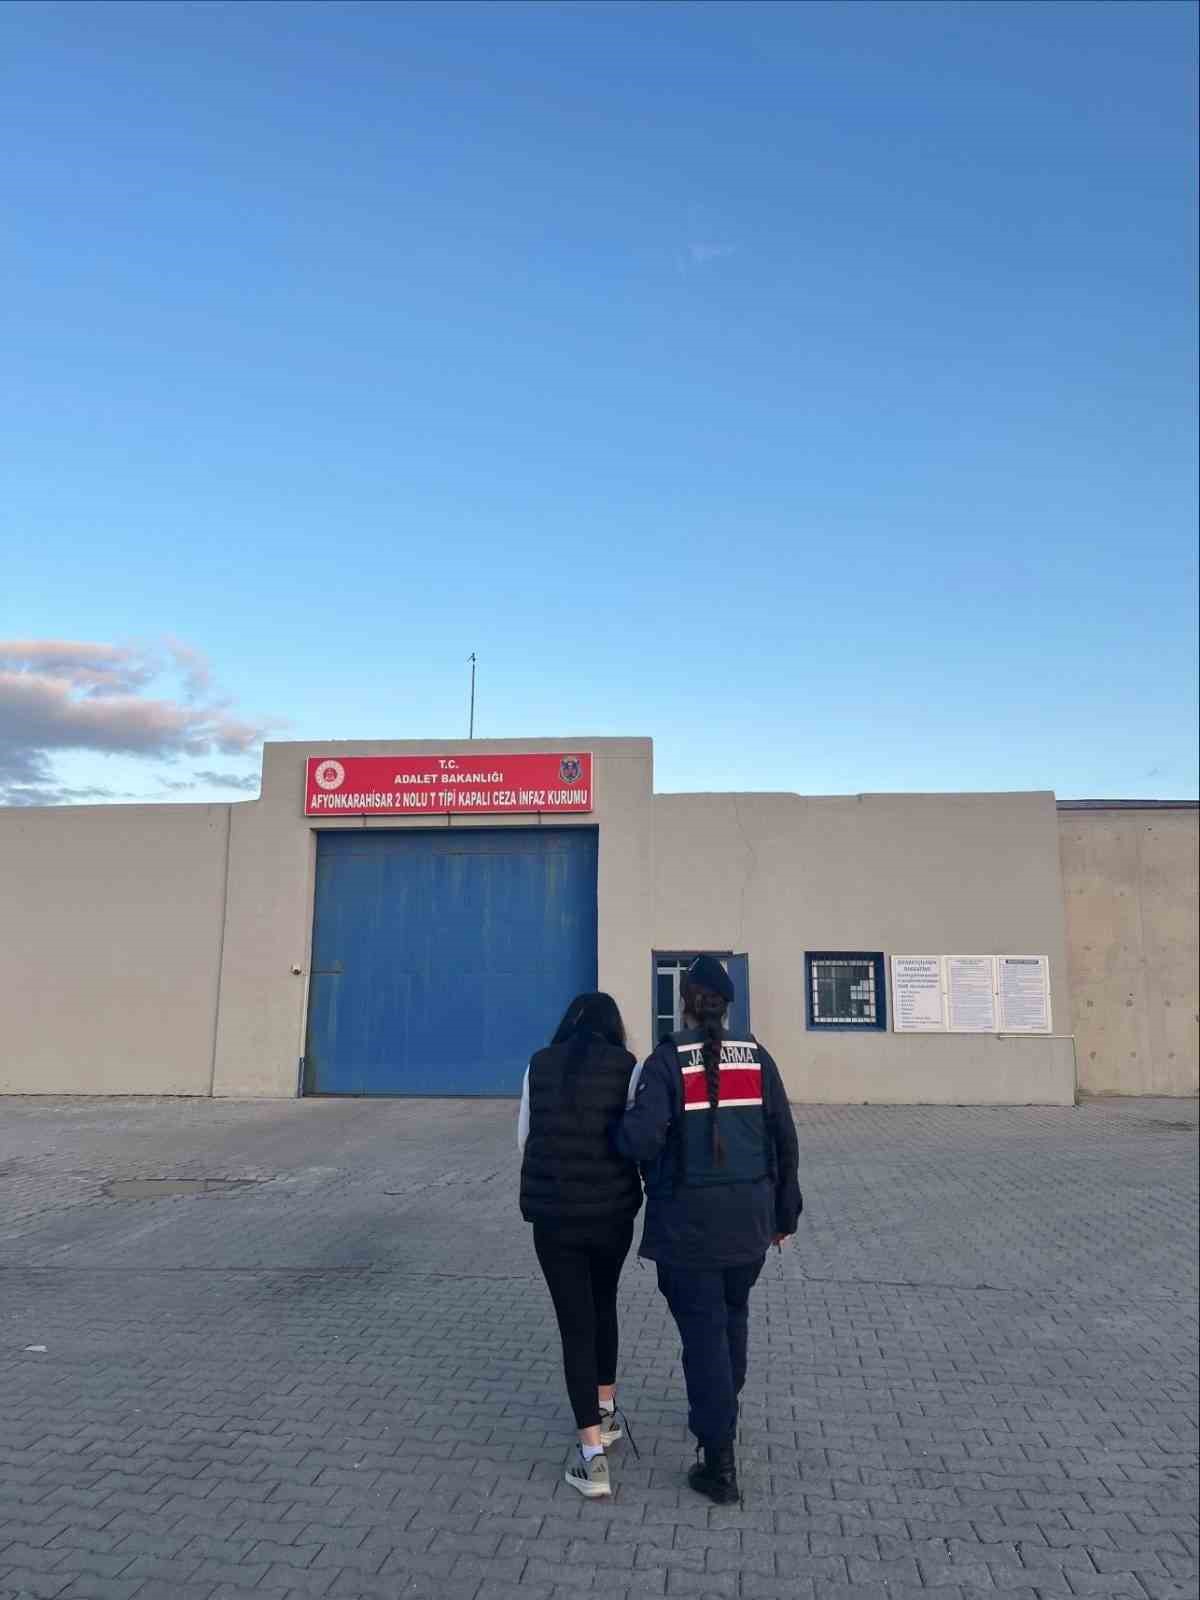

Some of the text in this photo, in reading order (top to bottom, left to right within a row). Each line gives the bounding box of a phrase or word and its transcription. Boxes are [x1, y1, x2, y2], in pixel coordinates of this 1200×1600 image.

[438, 759, 459, 769] T.C.
[394, 771, 504, 784] ADALET BAKANLIĞI
[311, 787, 587, 808] AFYONKARAHİSAR 2 NOLU T TİPİ KAPALI CEZA İNFAZ KURUMU
[689, 1047, 754, 1066] JAARMA
